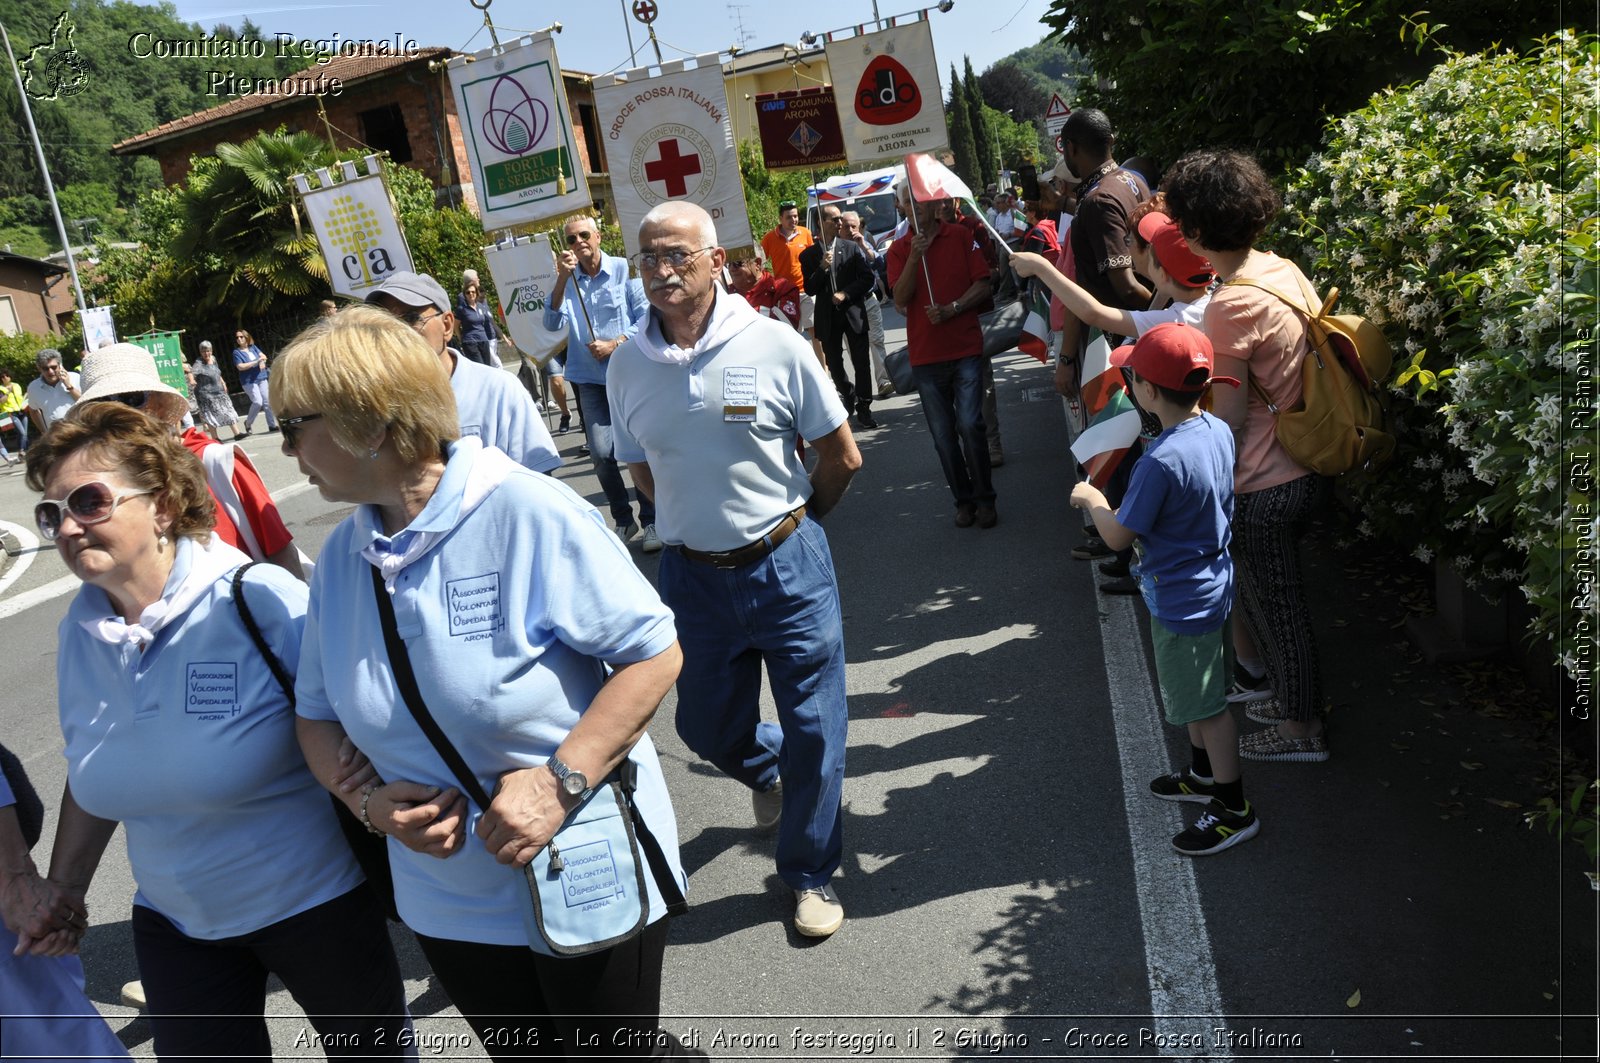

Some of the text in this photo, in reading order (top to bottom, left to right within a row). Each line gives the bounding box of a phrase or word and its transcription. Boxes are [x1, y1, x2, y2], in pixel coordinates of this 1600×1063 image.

[789, 96, 835, 109] COMUNAL
[609, 86, 722, 140] CROCE ROSSA ITALIANA
[784, 108, 820, 120] ARONA
[650, 126, 686, 138] GINEVRA
[687, 130, 699, 141] 22
[862, 127, 931, 145] GRUPPO COMUNALE
[641, 136, 650, 147] DI
[878, 139, 916, 153] ARONA
[697, 140, 714, 177] AGOSTO
[503, 154, 544, 176] FORTI
[632, 147, 657, 204] CONVENZIONE
[497, 178, 506, 190] E
[518, 187, 544, 199] ARONA
[711, 207, 724, 219] DI
[342, 231, 396, 287] cfa
[520, 284, 539, 294] PRO
[521, 291, 545, 301] LOCO
[464, 632, 494, 642] ARONA
[582, 900, 611, 912] ARONA
